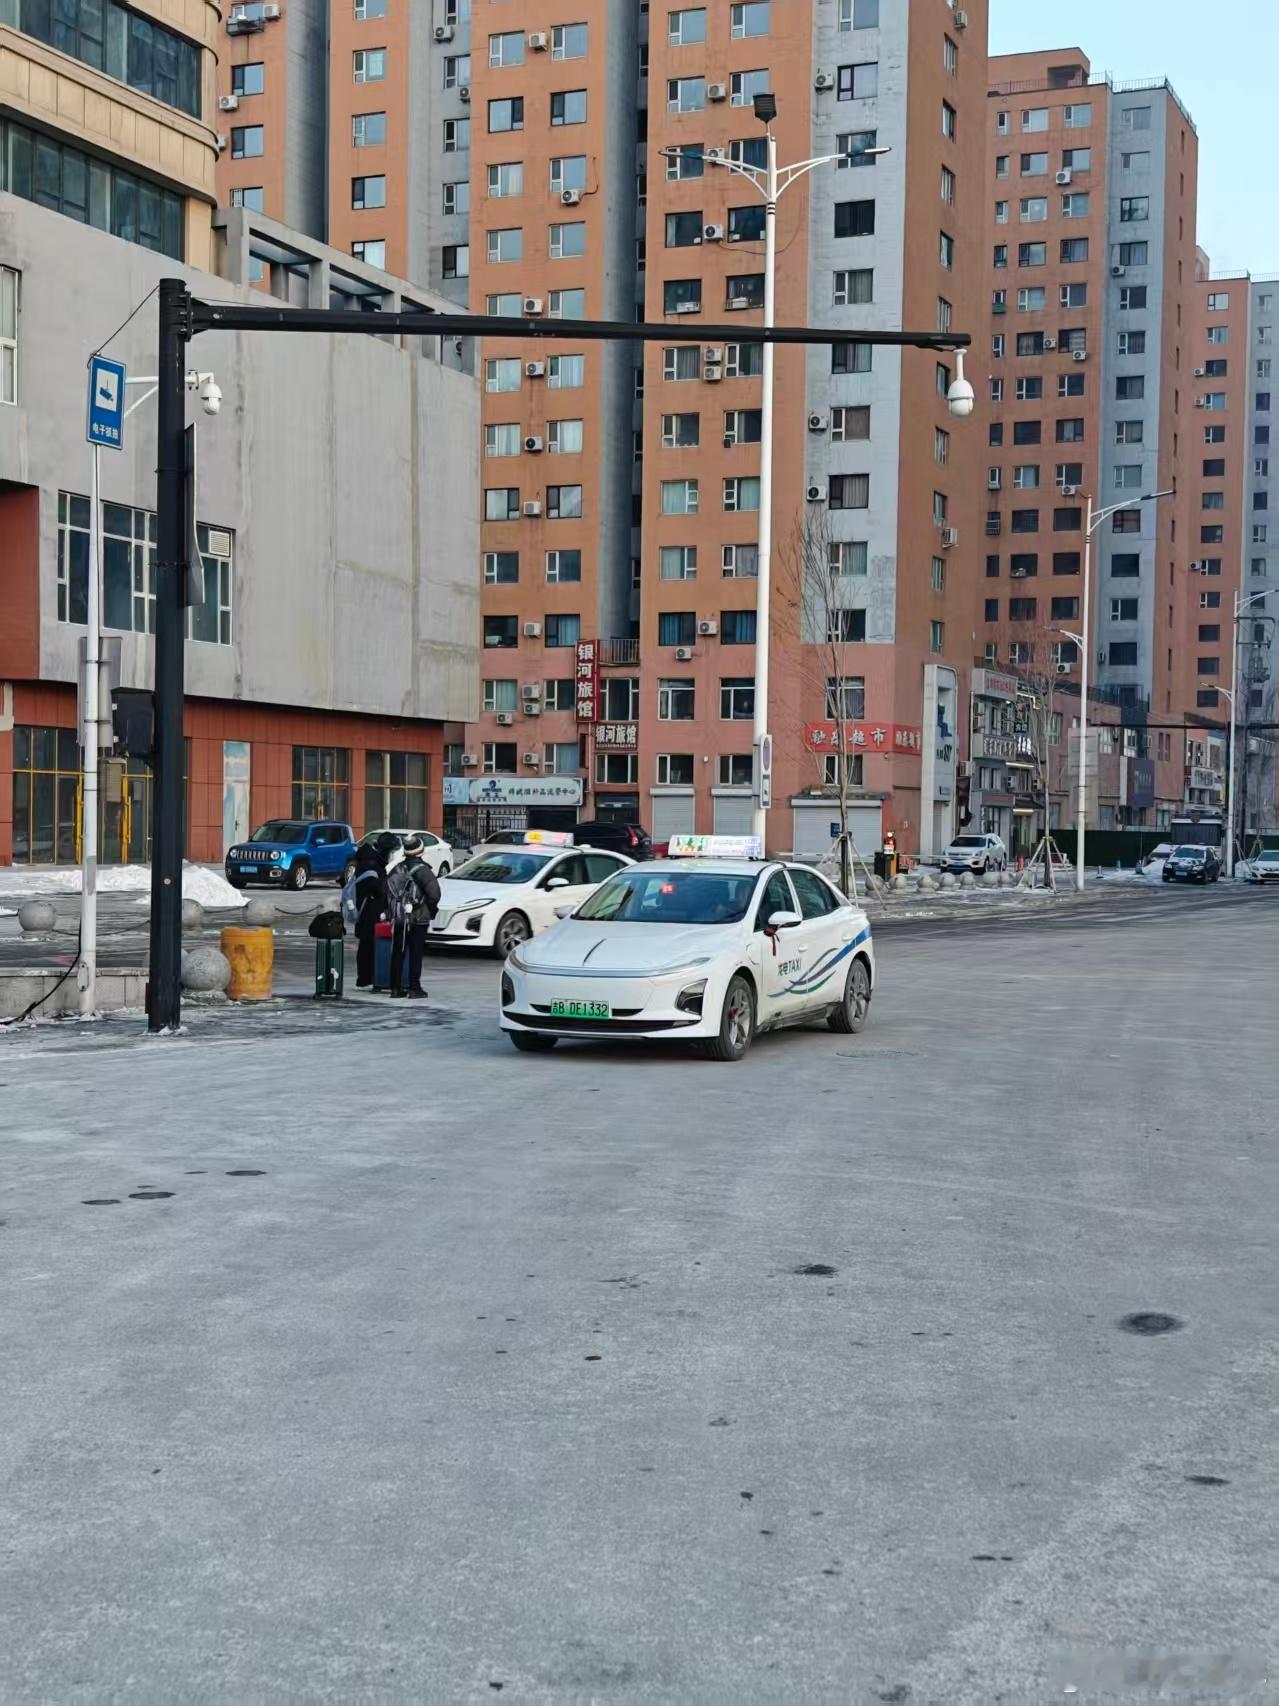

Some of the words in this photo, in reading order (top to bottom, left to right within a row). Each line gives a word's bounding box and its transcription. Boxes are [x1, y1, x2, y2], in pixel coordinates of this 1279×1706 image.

[578, 644, 594, 718] 银河旅馆
[596, 724, 636, 743] 银河旅馆
